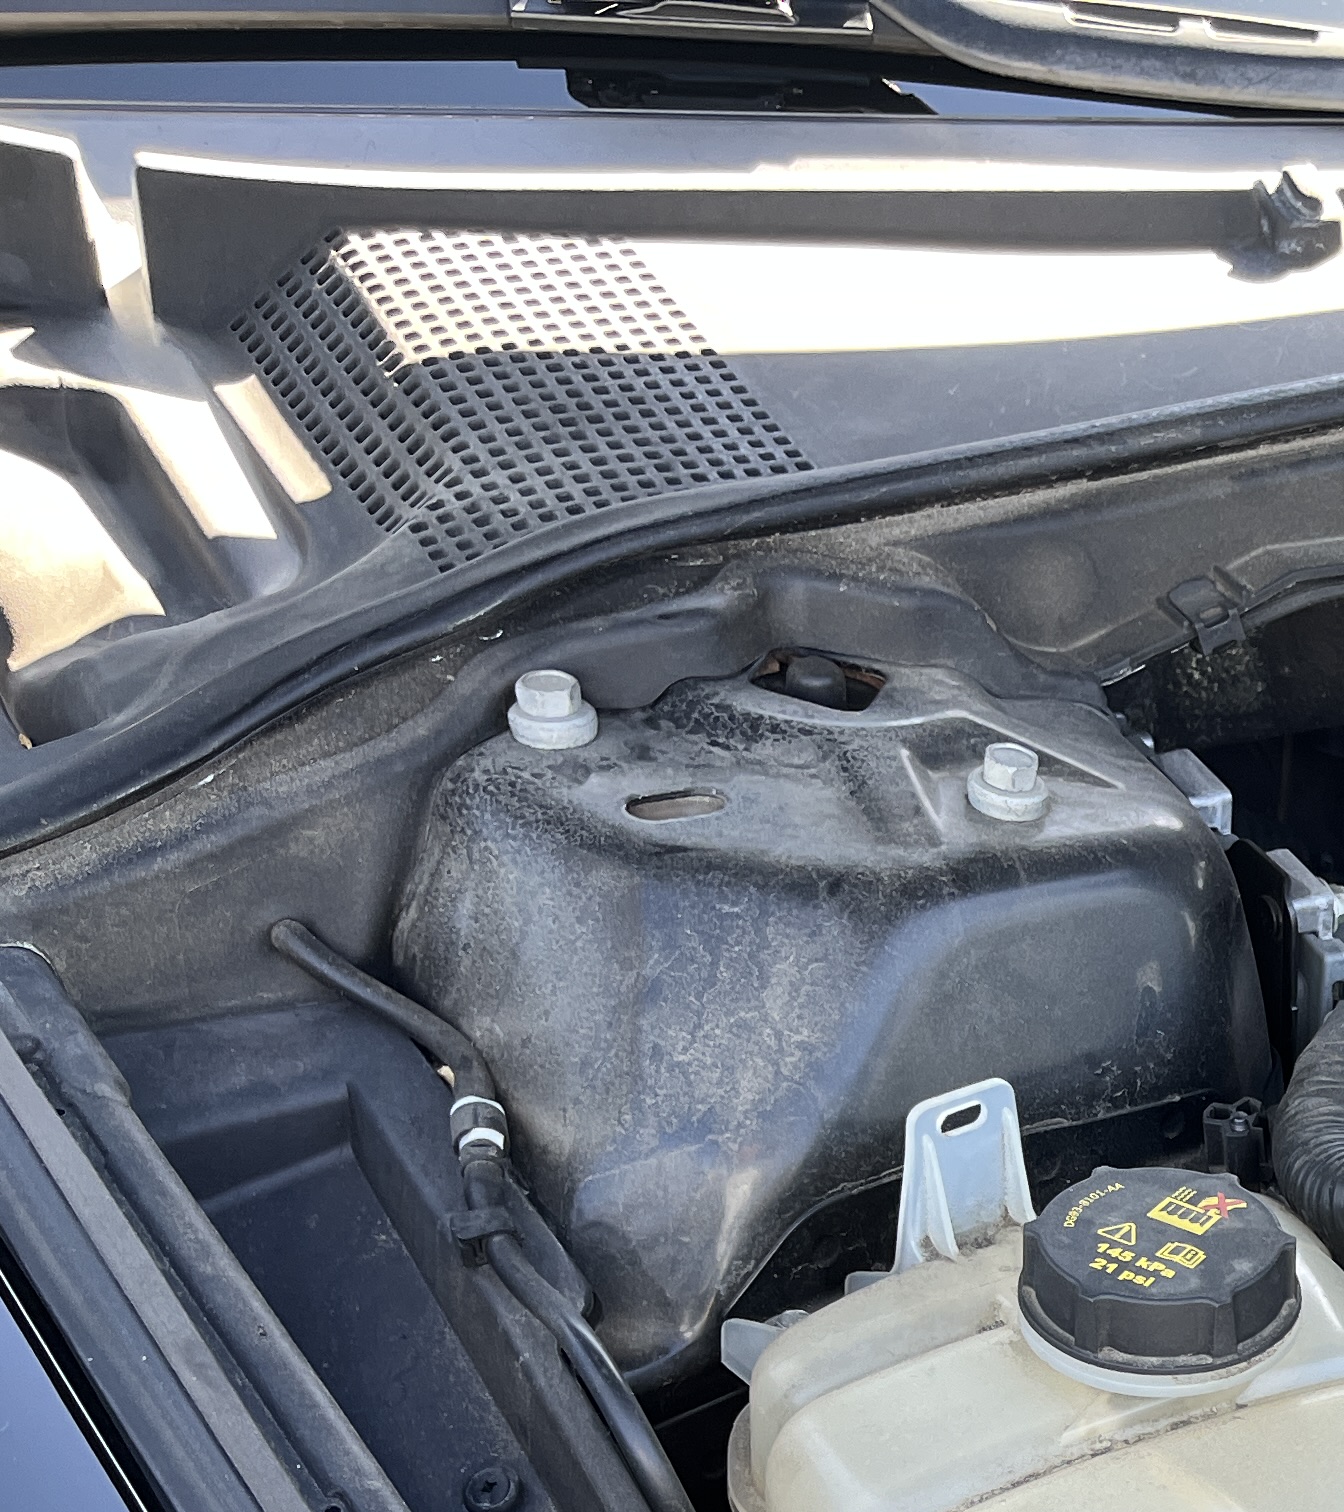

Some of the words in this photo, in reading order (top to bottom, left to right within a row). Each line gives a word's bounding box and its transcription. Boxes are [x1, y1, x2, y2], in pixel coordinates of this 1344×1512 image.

[1088, 1258, 1118, 1273] 21
[1117, 1271, 1155, 1287] psi
[1096, 1242, 1135, 1261] 145
[1134, 1257, 1175, 1278] kPa
